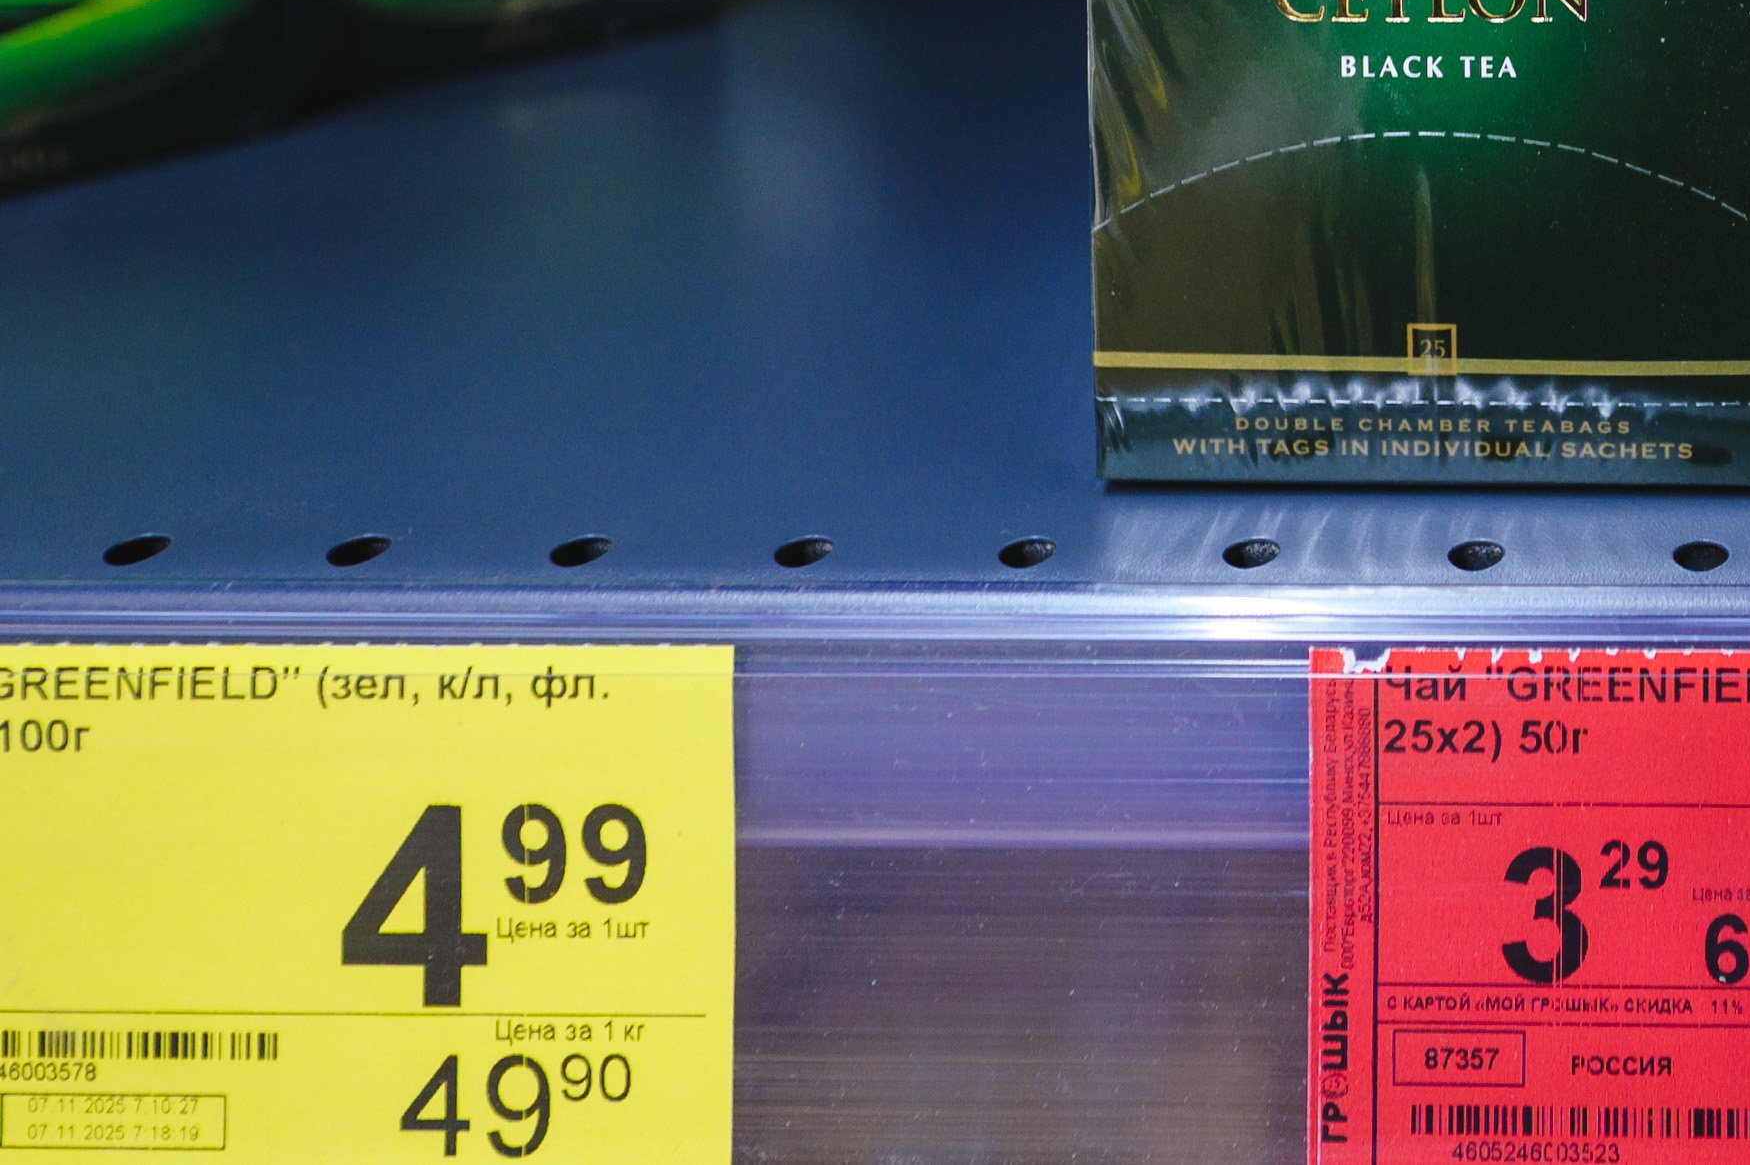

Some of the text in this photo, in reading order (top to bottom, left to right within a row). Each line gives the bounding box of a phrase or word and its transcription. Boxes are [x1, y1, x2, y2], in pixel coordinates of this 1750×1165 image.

[1341, 55, 1518, 79] BLACK TEA
[1420, 338, 1446, 360] 25
[1235, 416, 1632, 435] DOUBLE CHAMBER TEABAGS
[1174, 438, 1694, 461] WITH TAGS IN INDIVIDUAL SACHETS
[531, 666, 610, 708] фл.
[1384, 664, 1467, 702] Чай
[1519, 720, 1588, 754] 50г
[1387, 809, 1435, 829] Цена
[496, 917, 650, 944] Цена за 1шт
[1403, 992, 1471, 1011] КАРТОЙ
[1624, 997, 1694, 1014] СКИДКА
[1711, 998, 1743, 1015] 11%
[495, 1019, 646, 1046] Цена за 1 кг
[1322, 972, 1349, 1143] ГРОШЫК
[1424, 1047, 1500, 1070] 87357
[1571, 1055, 1673, 1077] РОССИЯ
